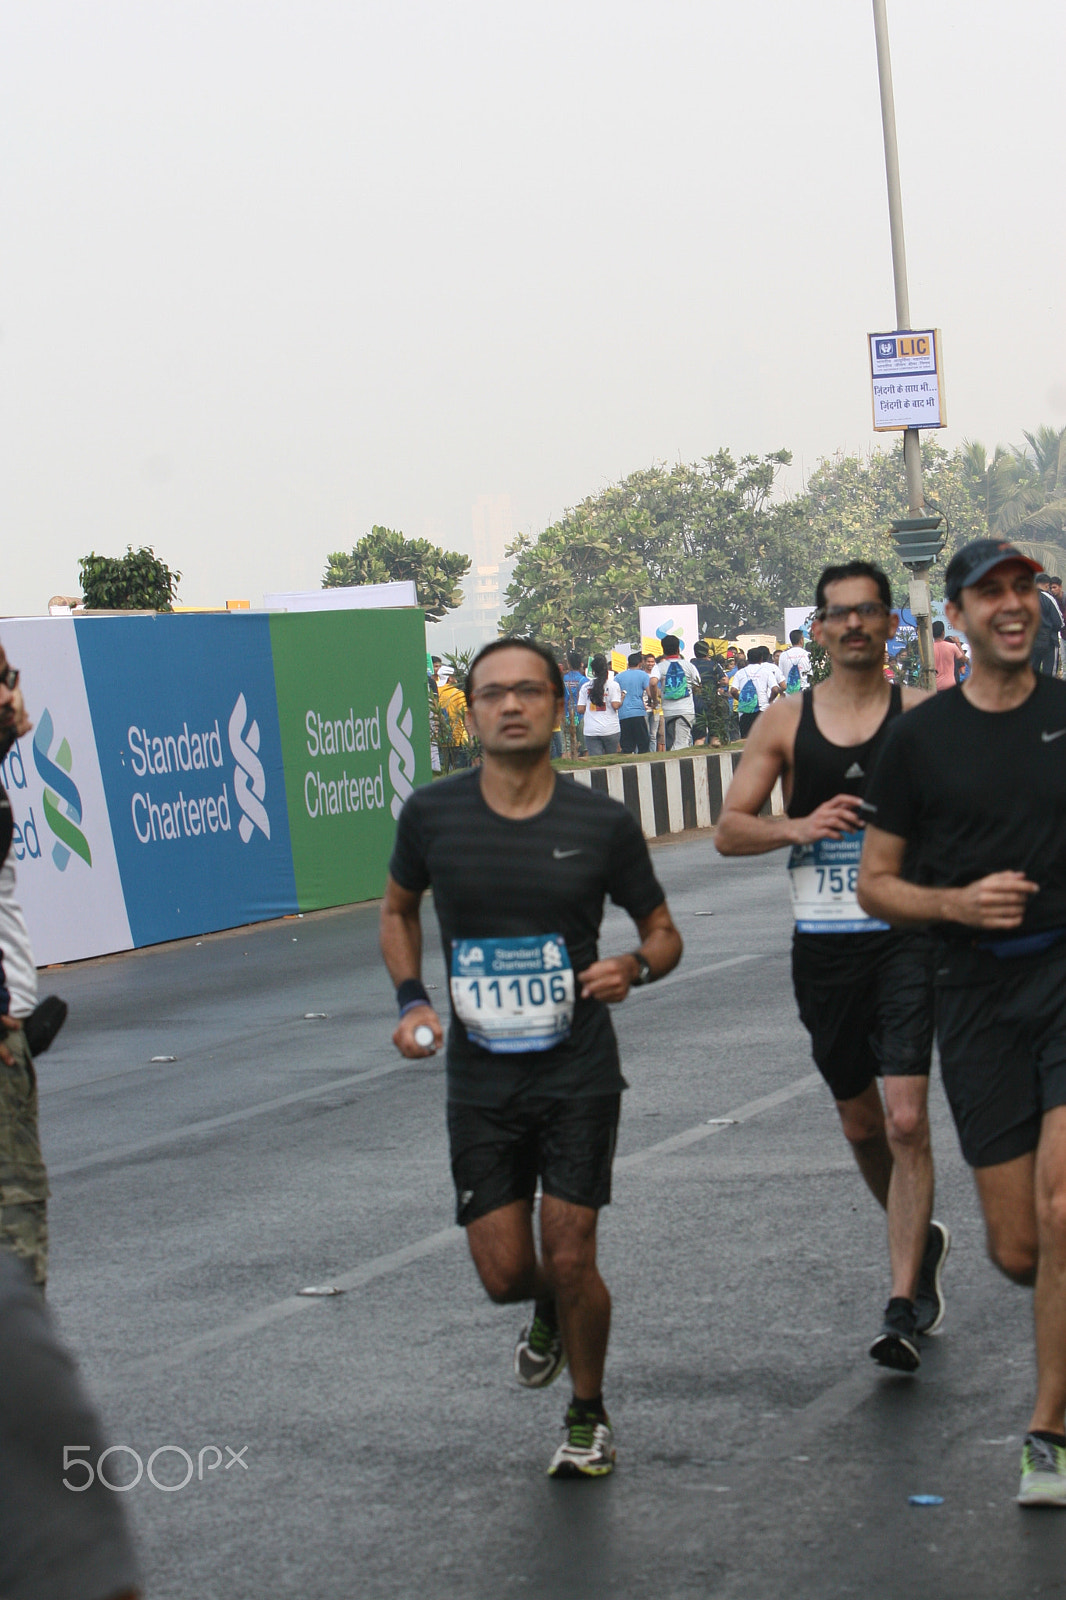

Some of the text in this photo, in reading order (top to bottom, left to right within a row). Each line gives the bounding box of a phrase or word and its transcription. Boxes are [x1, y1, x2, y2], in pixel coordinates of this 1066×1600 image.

[900, 338, 926, 355] LIC
[926, 396, 935, 407] भी
[128, 719, 224, 777] Standard
[305, 706, 381, 757] Standard
[131, 782, 232, 843] Chartered
[304, 764, 385, 818] Chartered
[468, 974, 566, 1009] 11106
